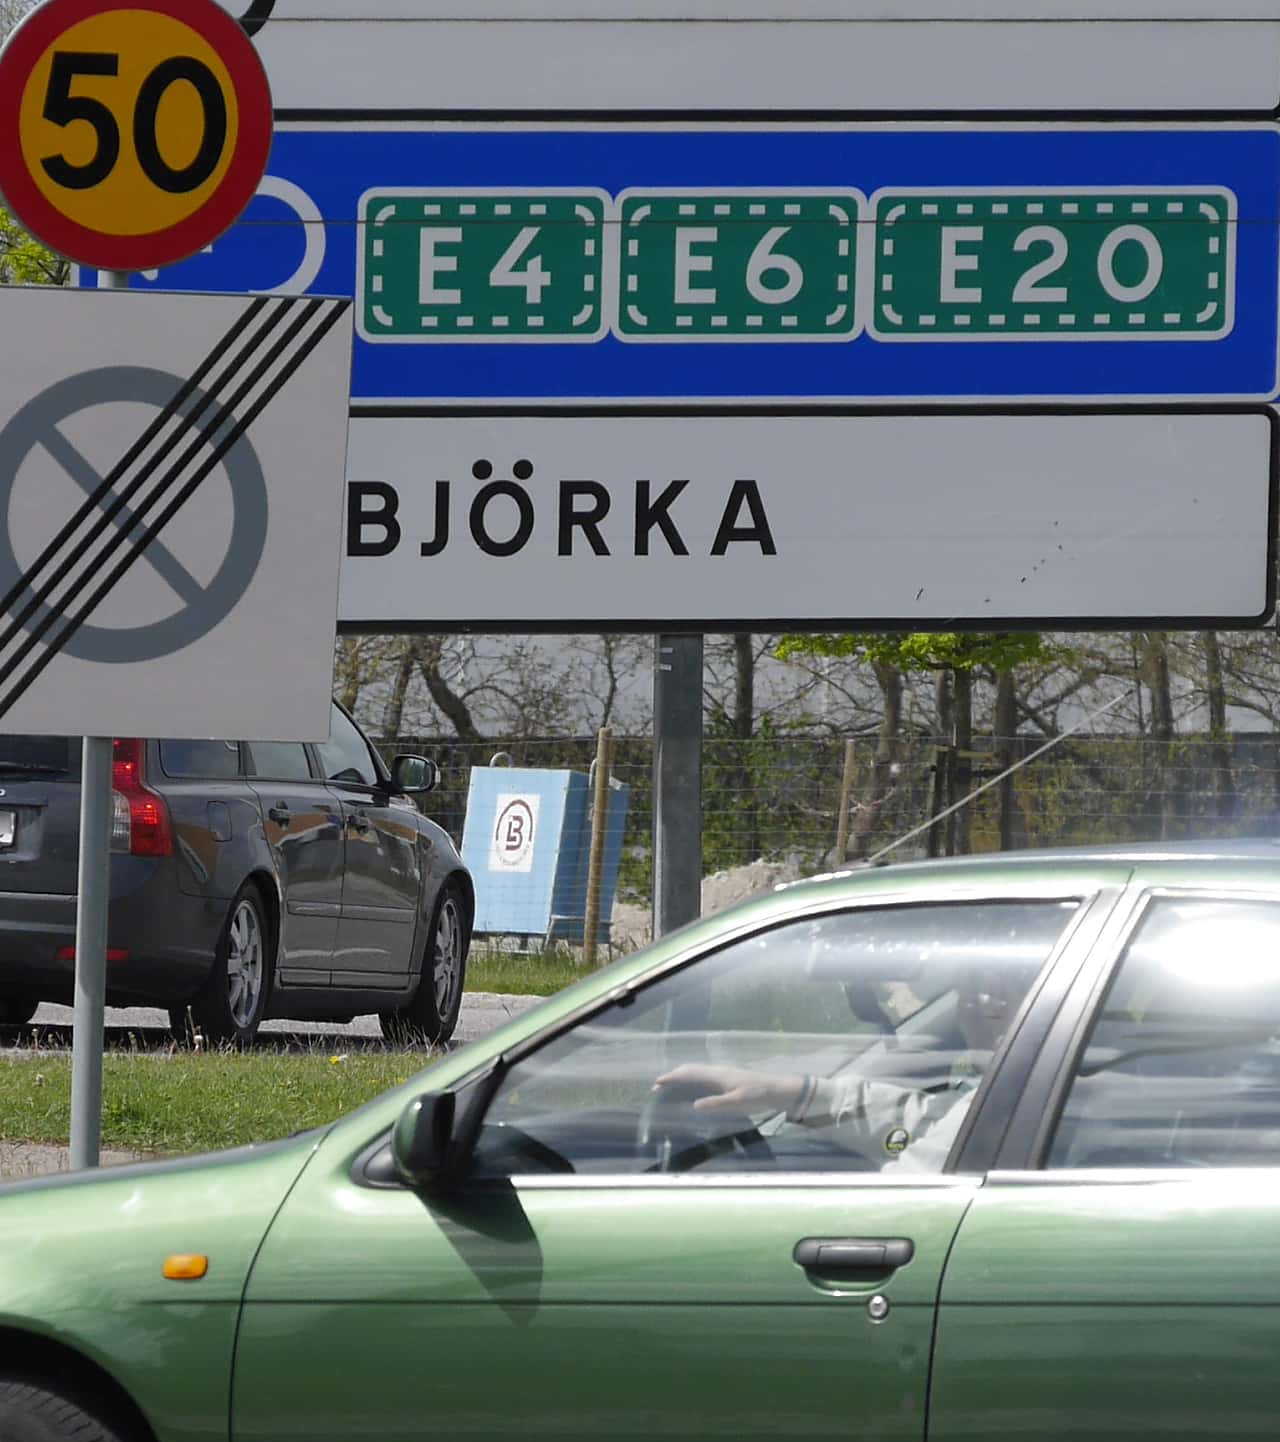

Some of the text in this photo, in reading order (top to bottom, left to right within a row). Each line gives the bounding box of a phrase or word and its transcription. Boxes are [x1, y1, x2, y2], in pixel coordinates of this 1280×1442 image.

[40, 51, 227, 194] 50
[939, 224, 1164, 304] E20
[346, 459, 778, 558] BJÖRKA
